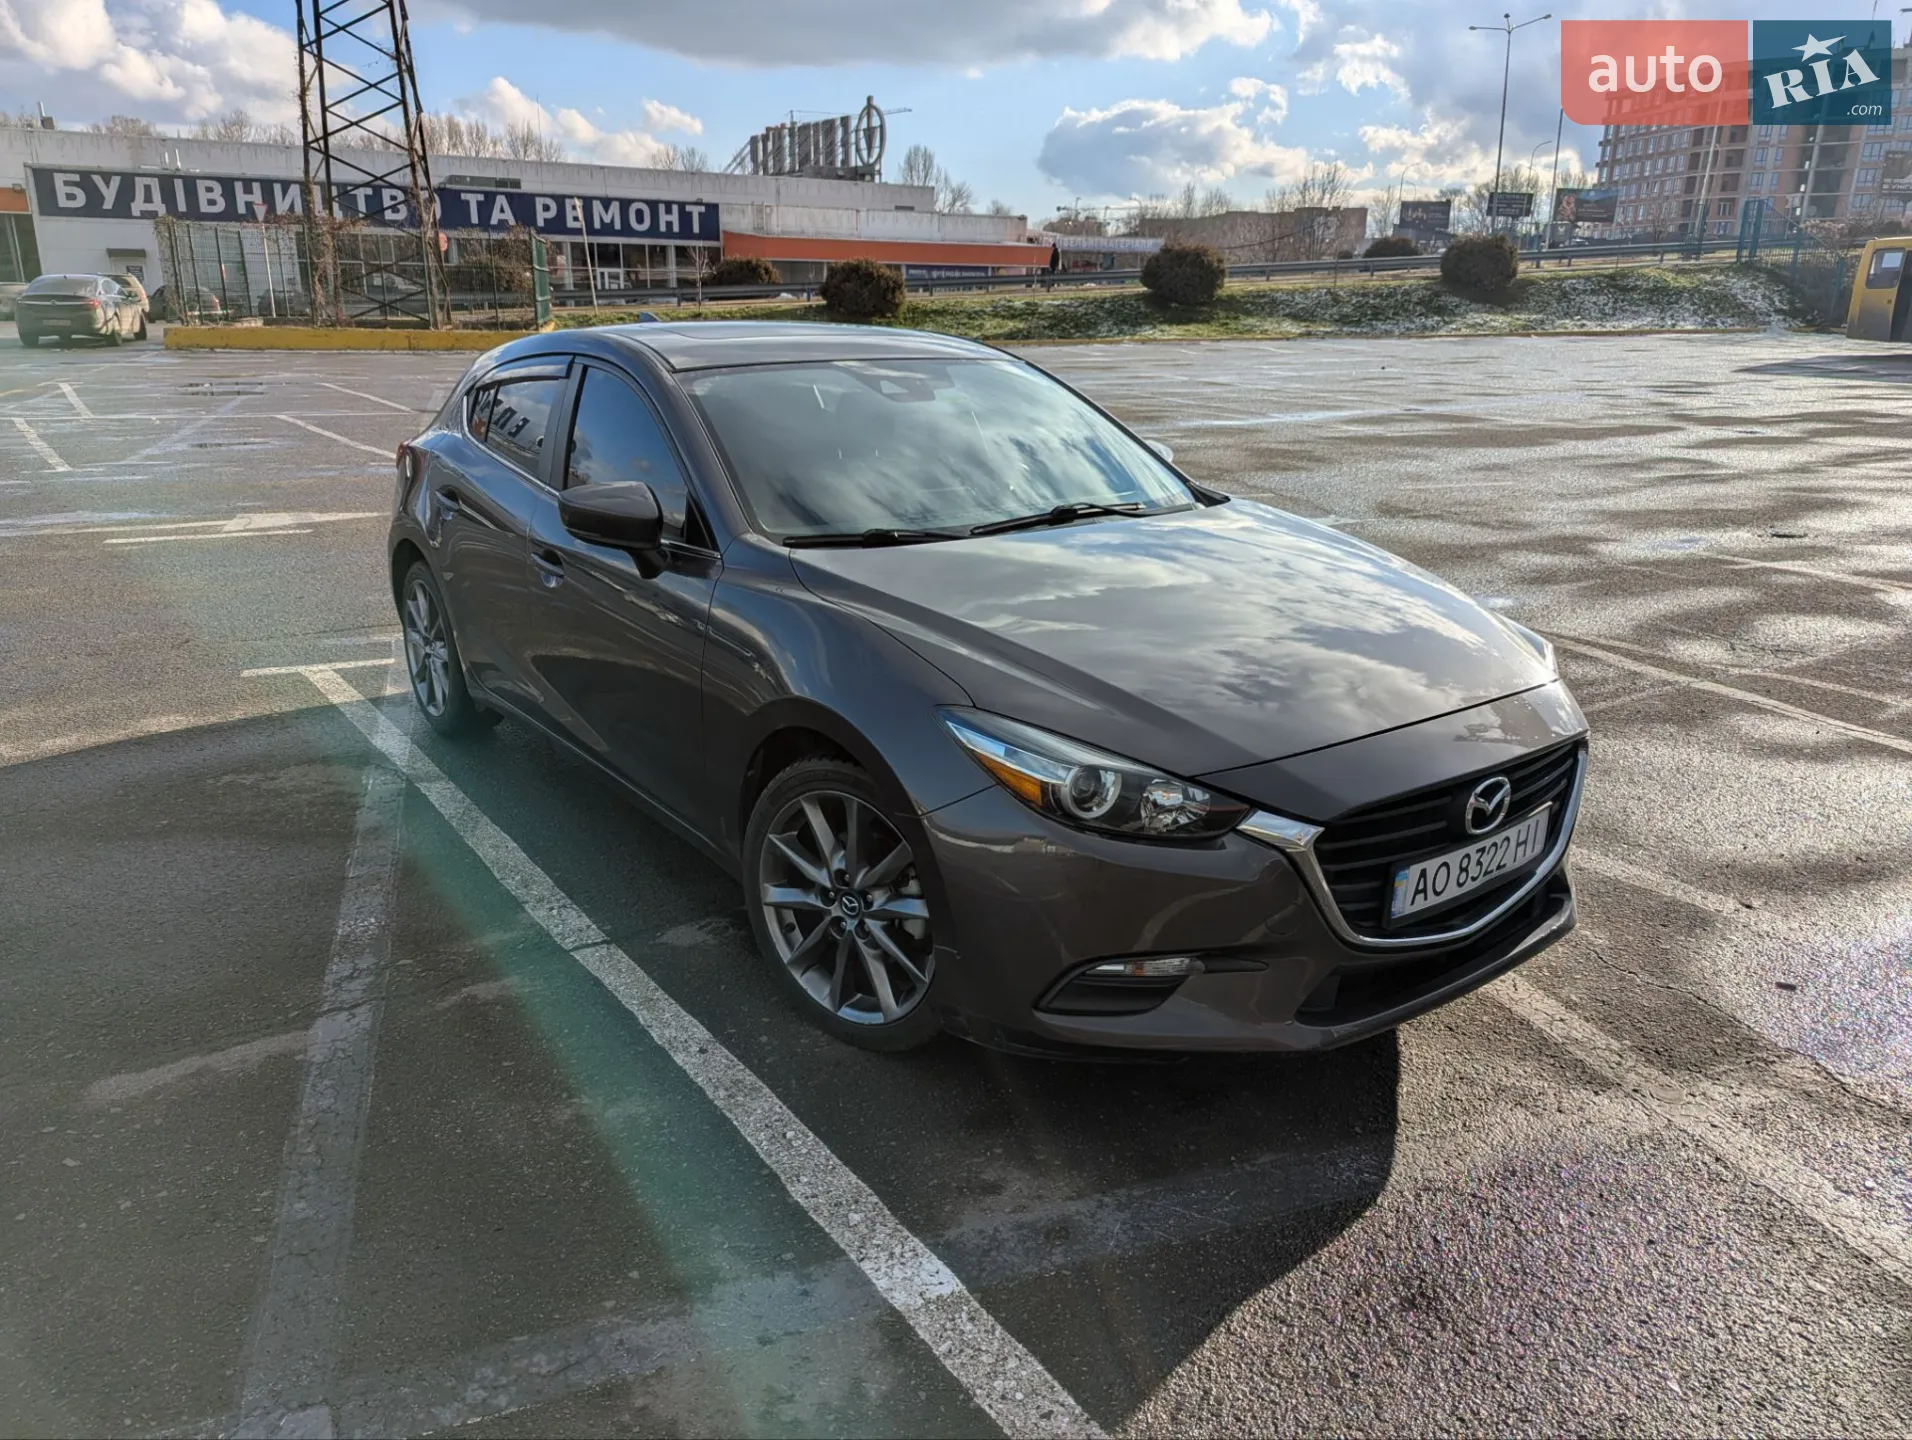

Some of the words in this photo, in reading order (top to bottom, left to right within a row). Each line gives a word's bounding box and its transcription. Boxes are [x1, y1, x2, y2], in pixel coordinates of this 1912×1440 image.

[460, 193, 518, 226] ТА
[535, 197, 706, 234] РЕМОНТ
[1410, 861, 1450, 907] AO
[1456, 836, 1511, 888] 8322
[1513, 819, 1540, 864] HI
